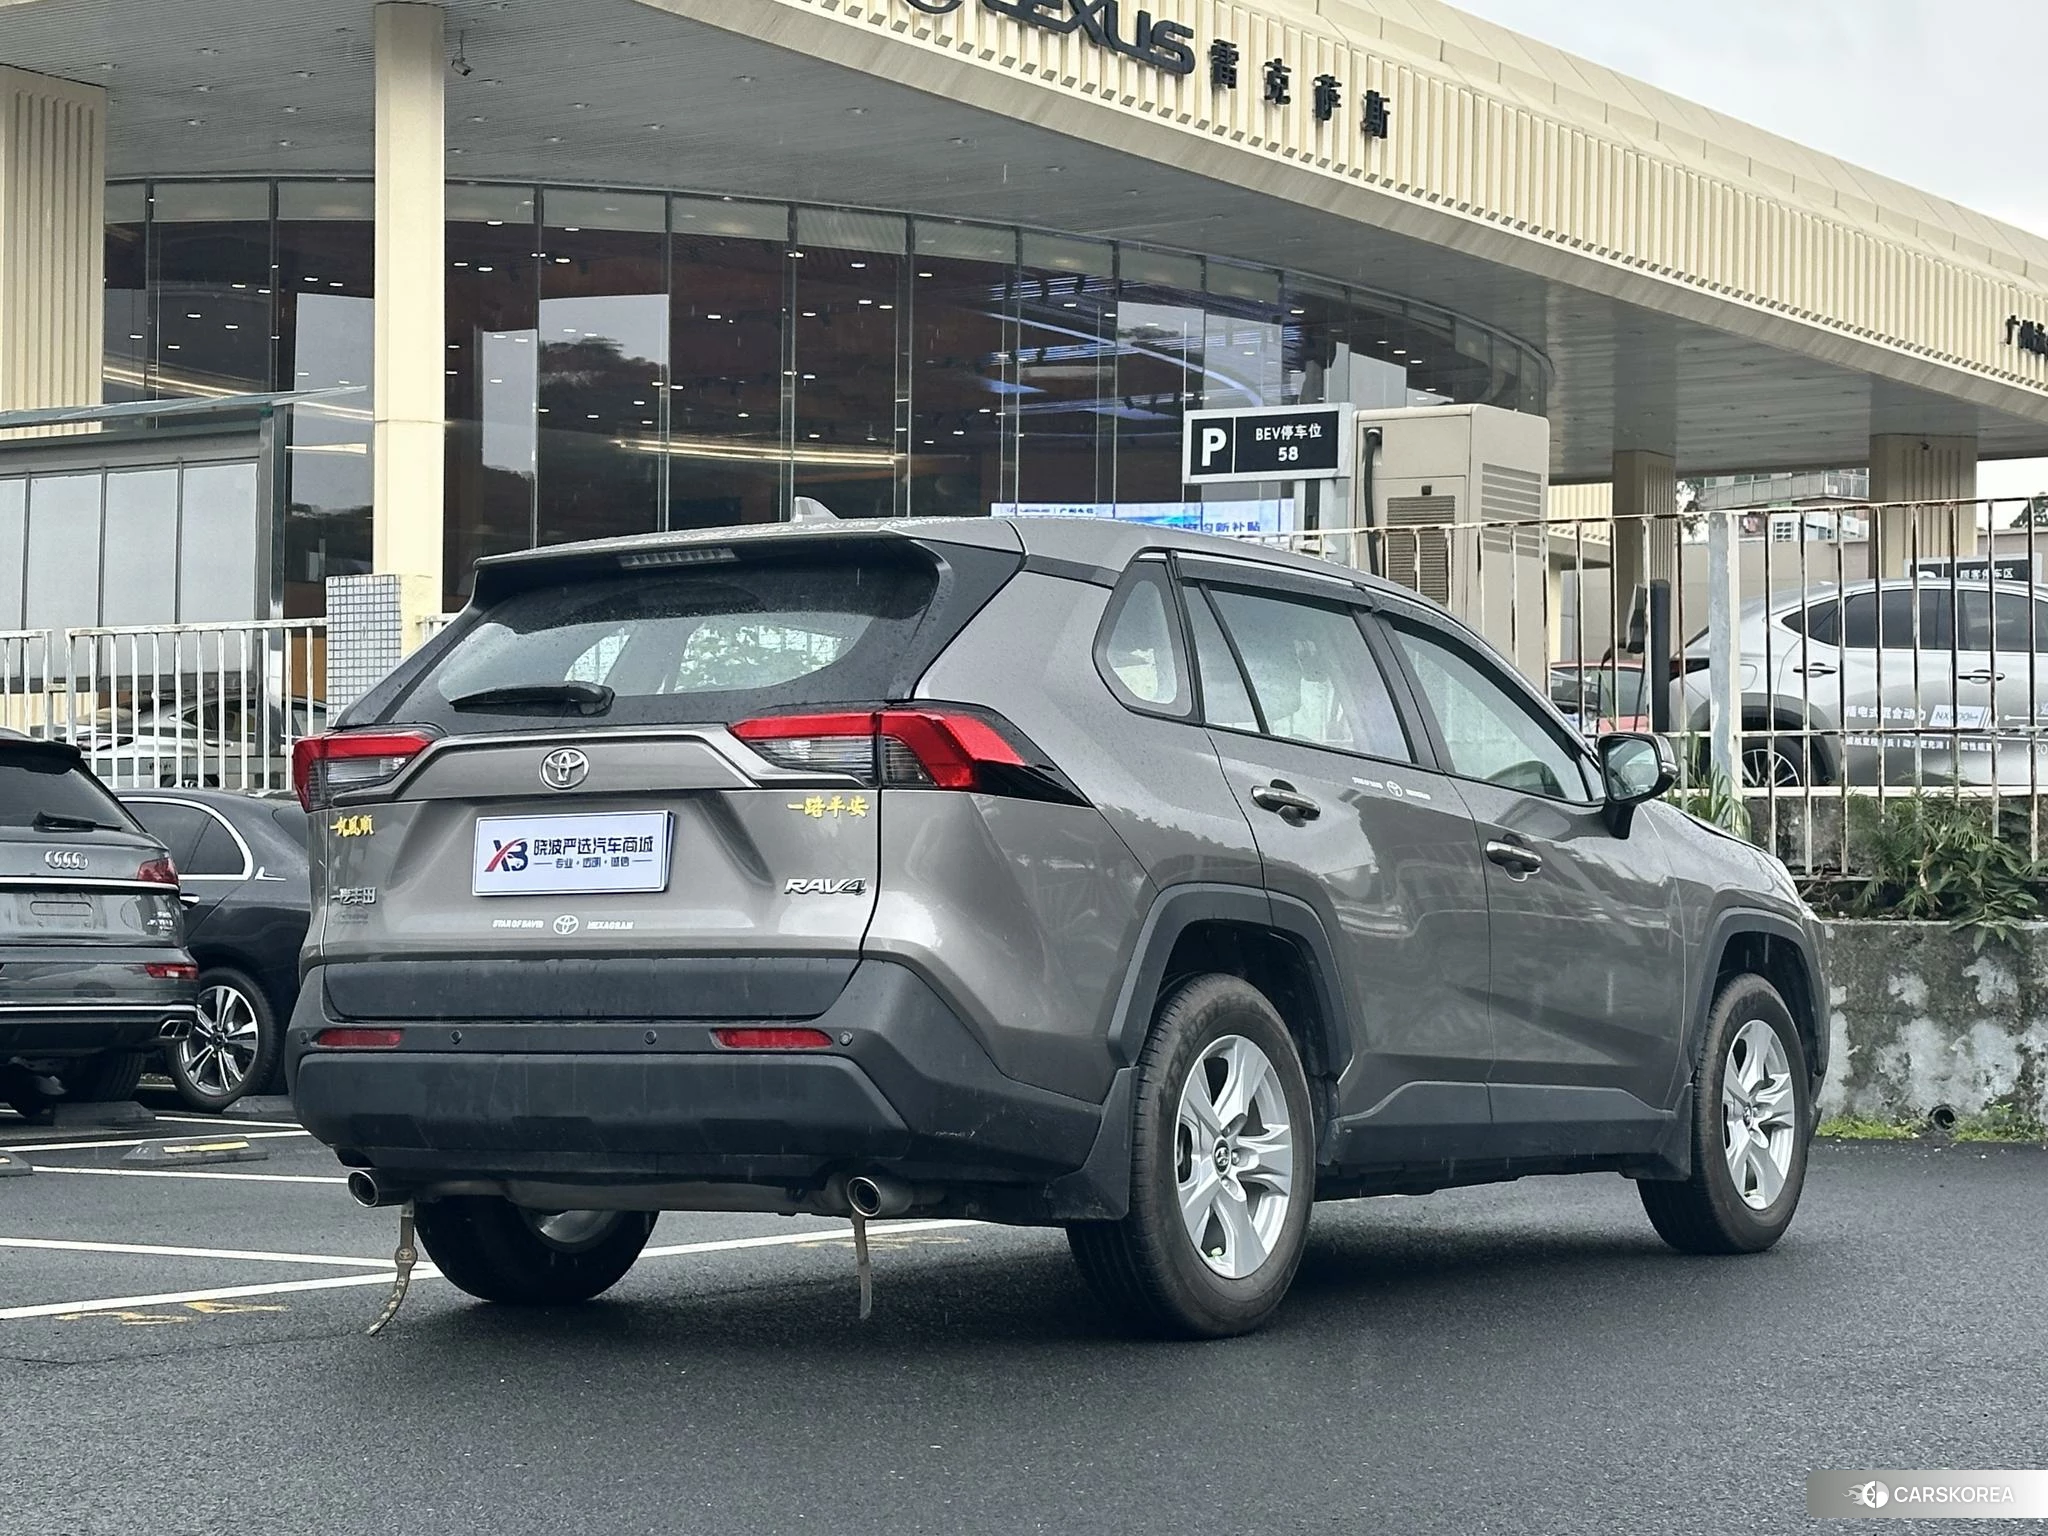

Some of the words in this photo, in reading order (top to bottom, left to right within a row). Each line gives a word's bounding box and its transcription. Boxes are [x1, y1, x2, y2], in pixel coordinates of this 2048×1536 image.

[1255, 423, 1322, 442] BEV停车位
[1201, 428, 1227, 467] P
[1278, 447, 1299, 461] 58
[787, 796, 870, 818] 一路平安
[534, 836, 653, 856] 晓波严选汽车商城
[784, 878, 867, 895] RAV4
